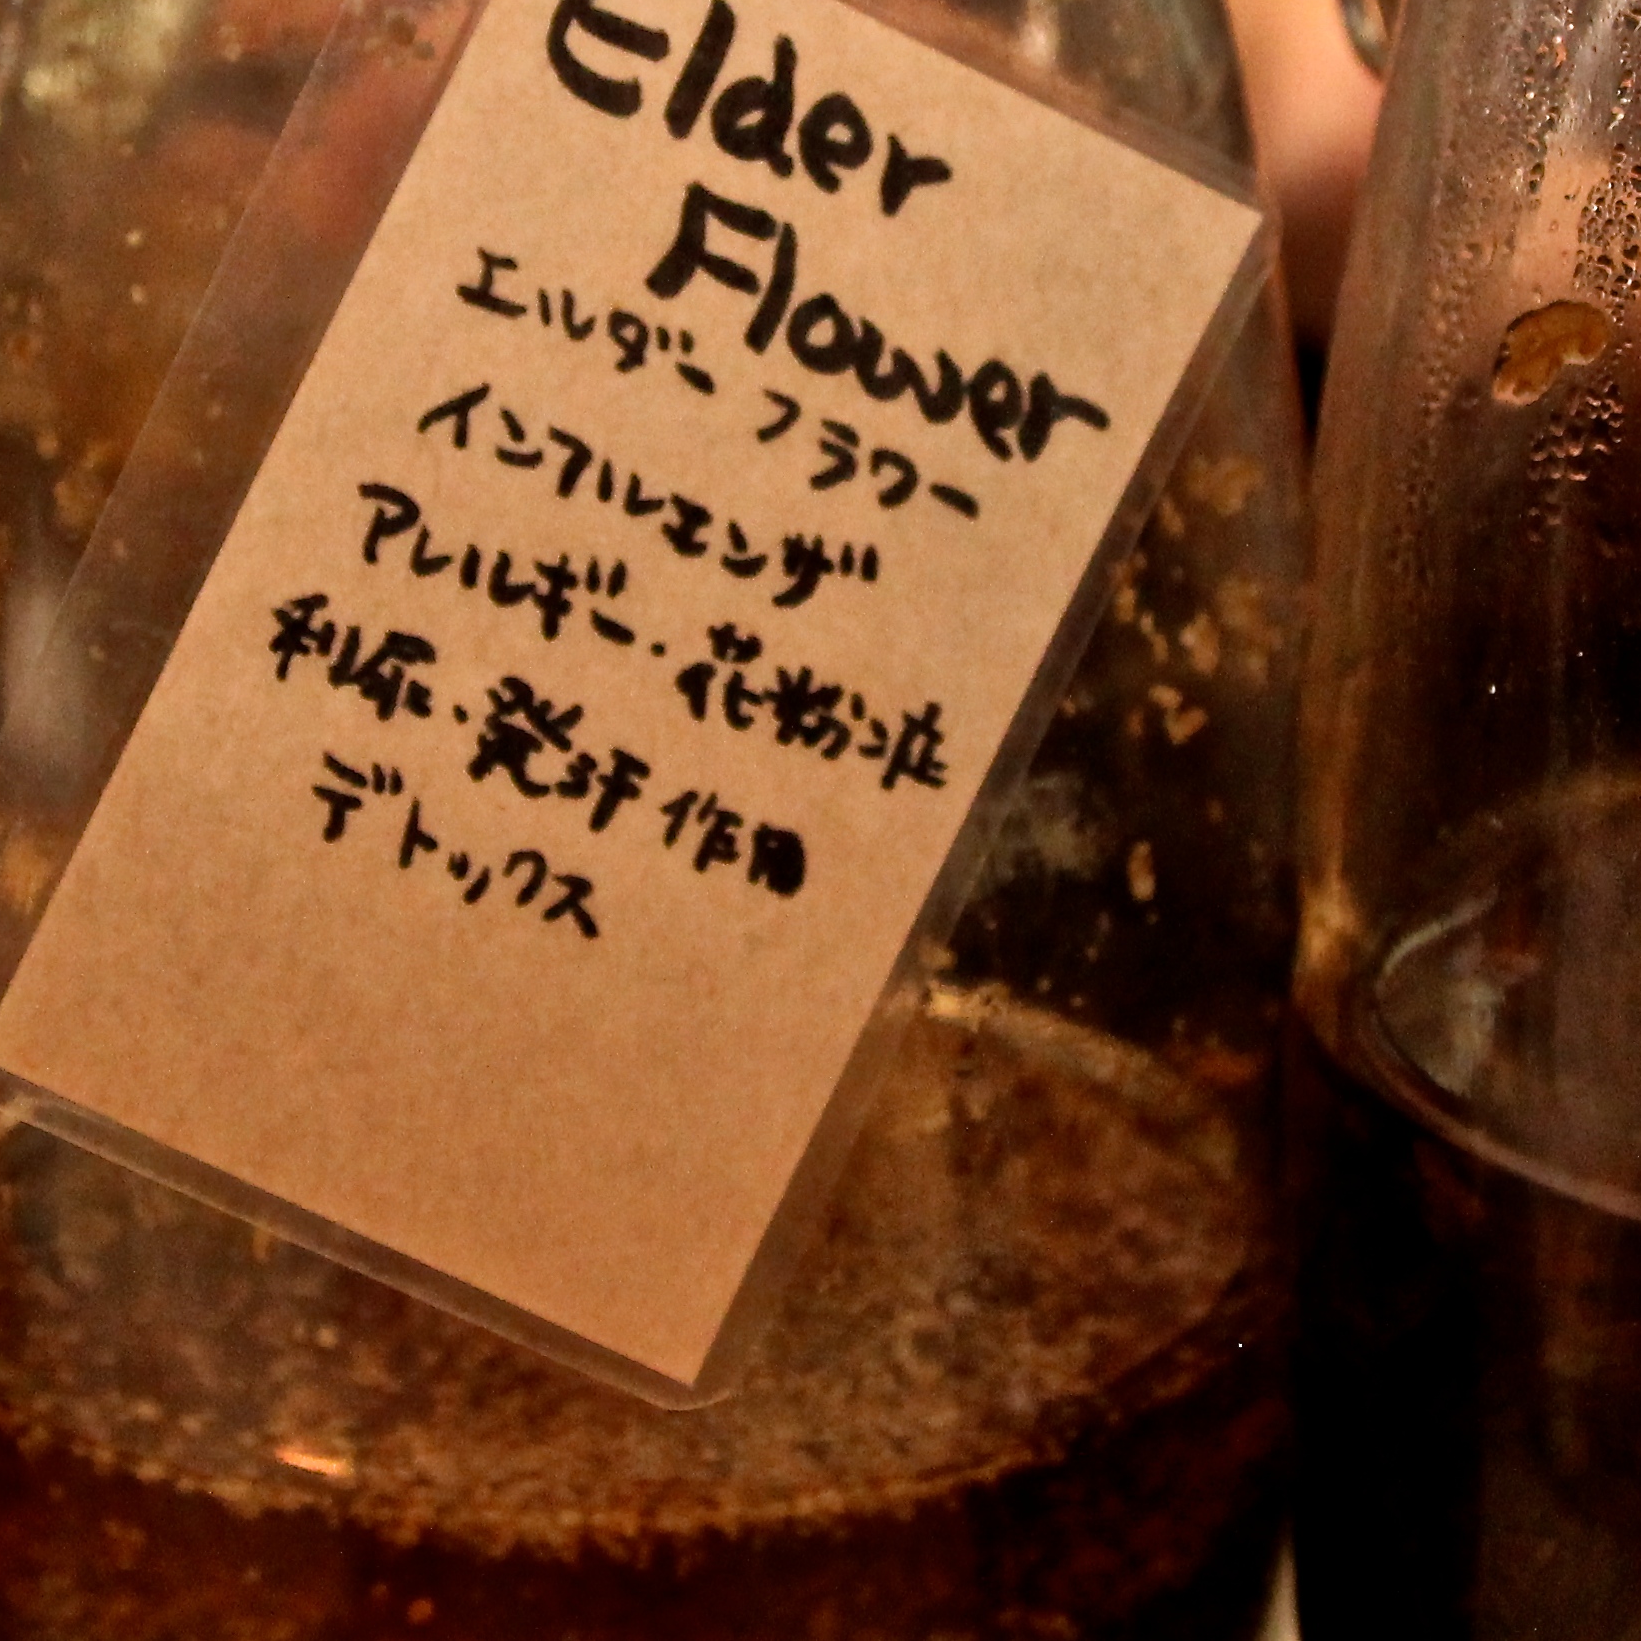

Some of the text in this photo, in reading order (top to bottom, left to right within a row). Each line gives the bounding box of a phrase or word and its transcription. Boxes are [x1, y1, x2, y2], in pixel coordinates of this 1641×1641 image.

[646, 182, 1110, 462] Flower
[419, 383, 879, 609] インフルエンザ
[312, 753, 599, 940] デトックス
